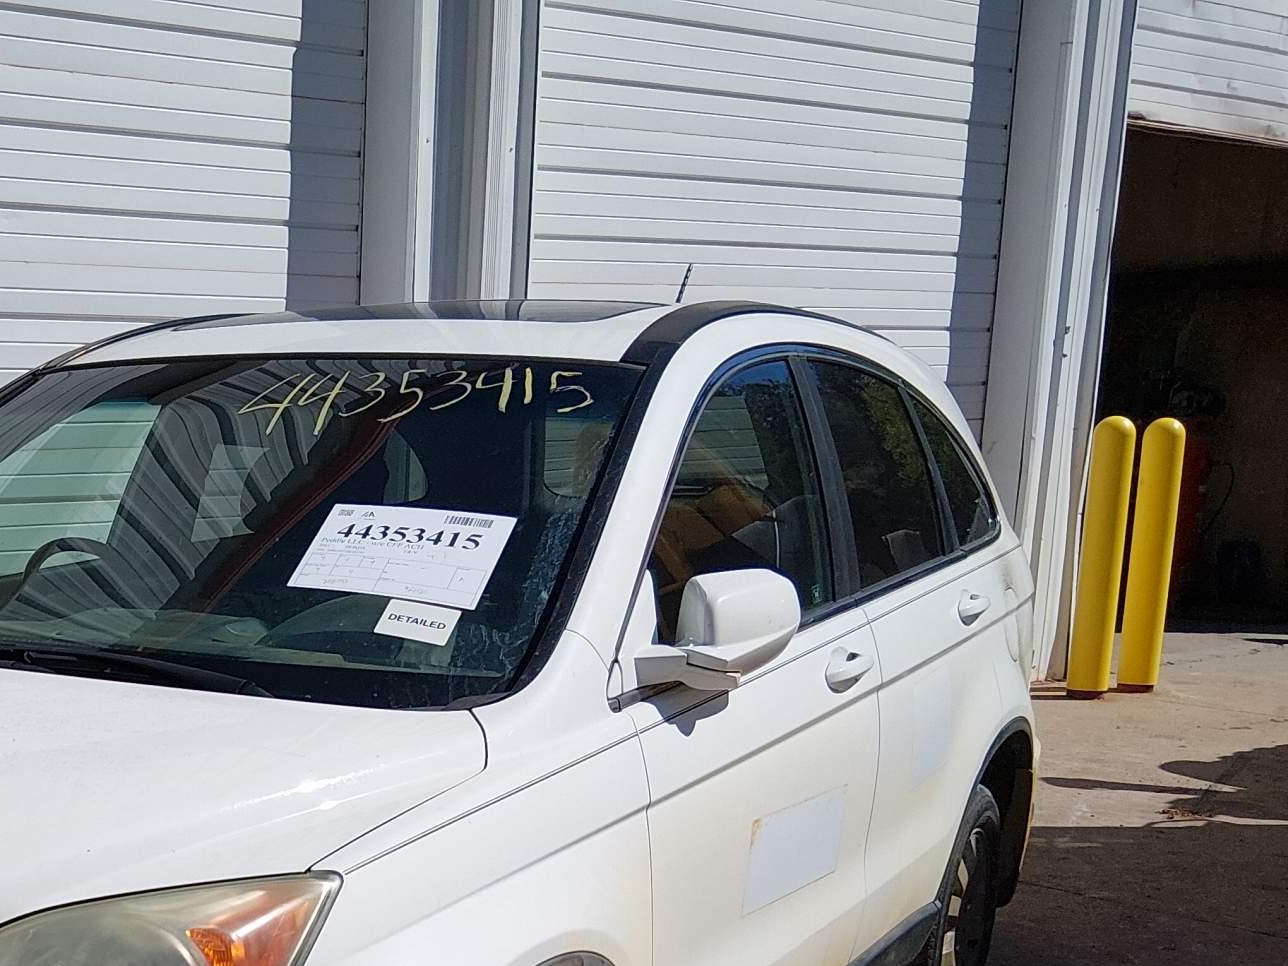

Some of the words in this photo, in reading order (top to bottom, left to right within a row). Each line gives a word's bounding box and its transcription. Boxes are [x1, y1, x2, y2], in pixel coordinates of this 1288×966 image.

[238, 367, 596, 436] 44353415
[336, 523, 485, 551] 44353415
[387, 612, 447, 631] DETAILED
